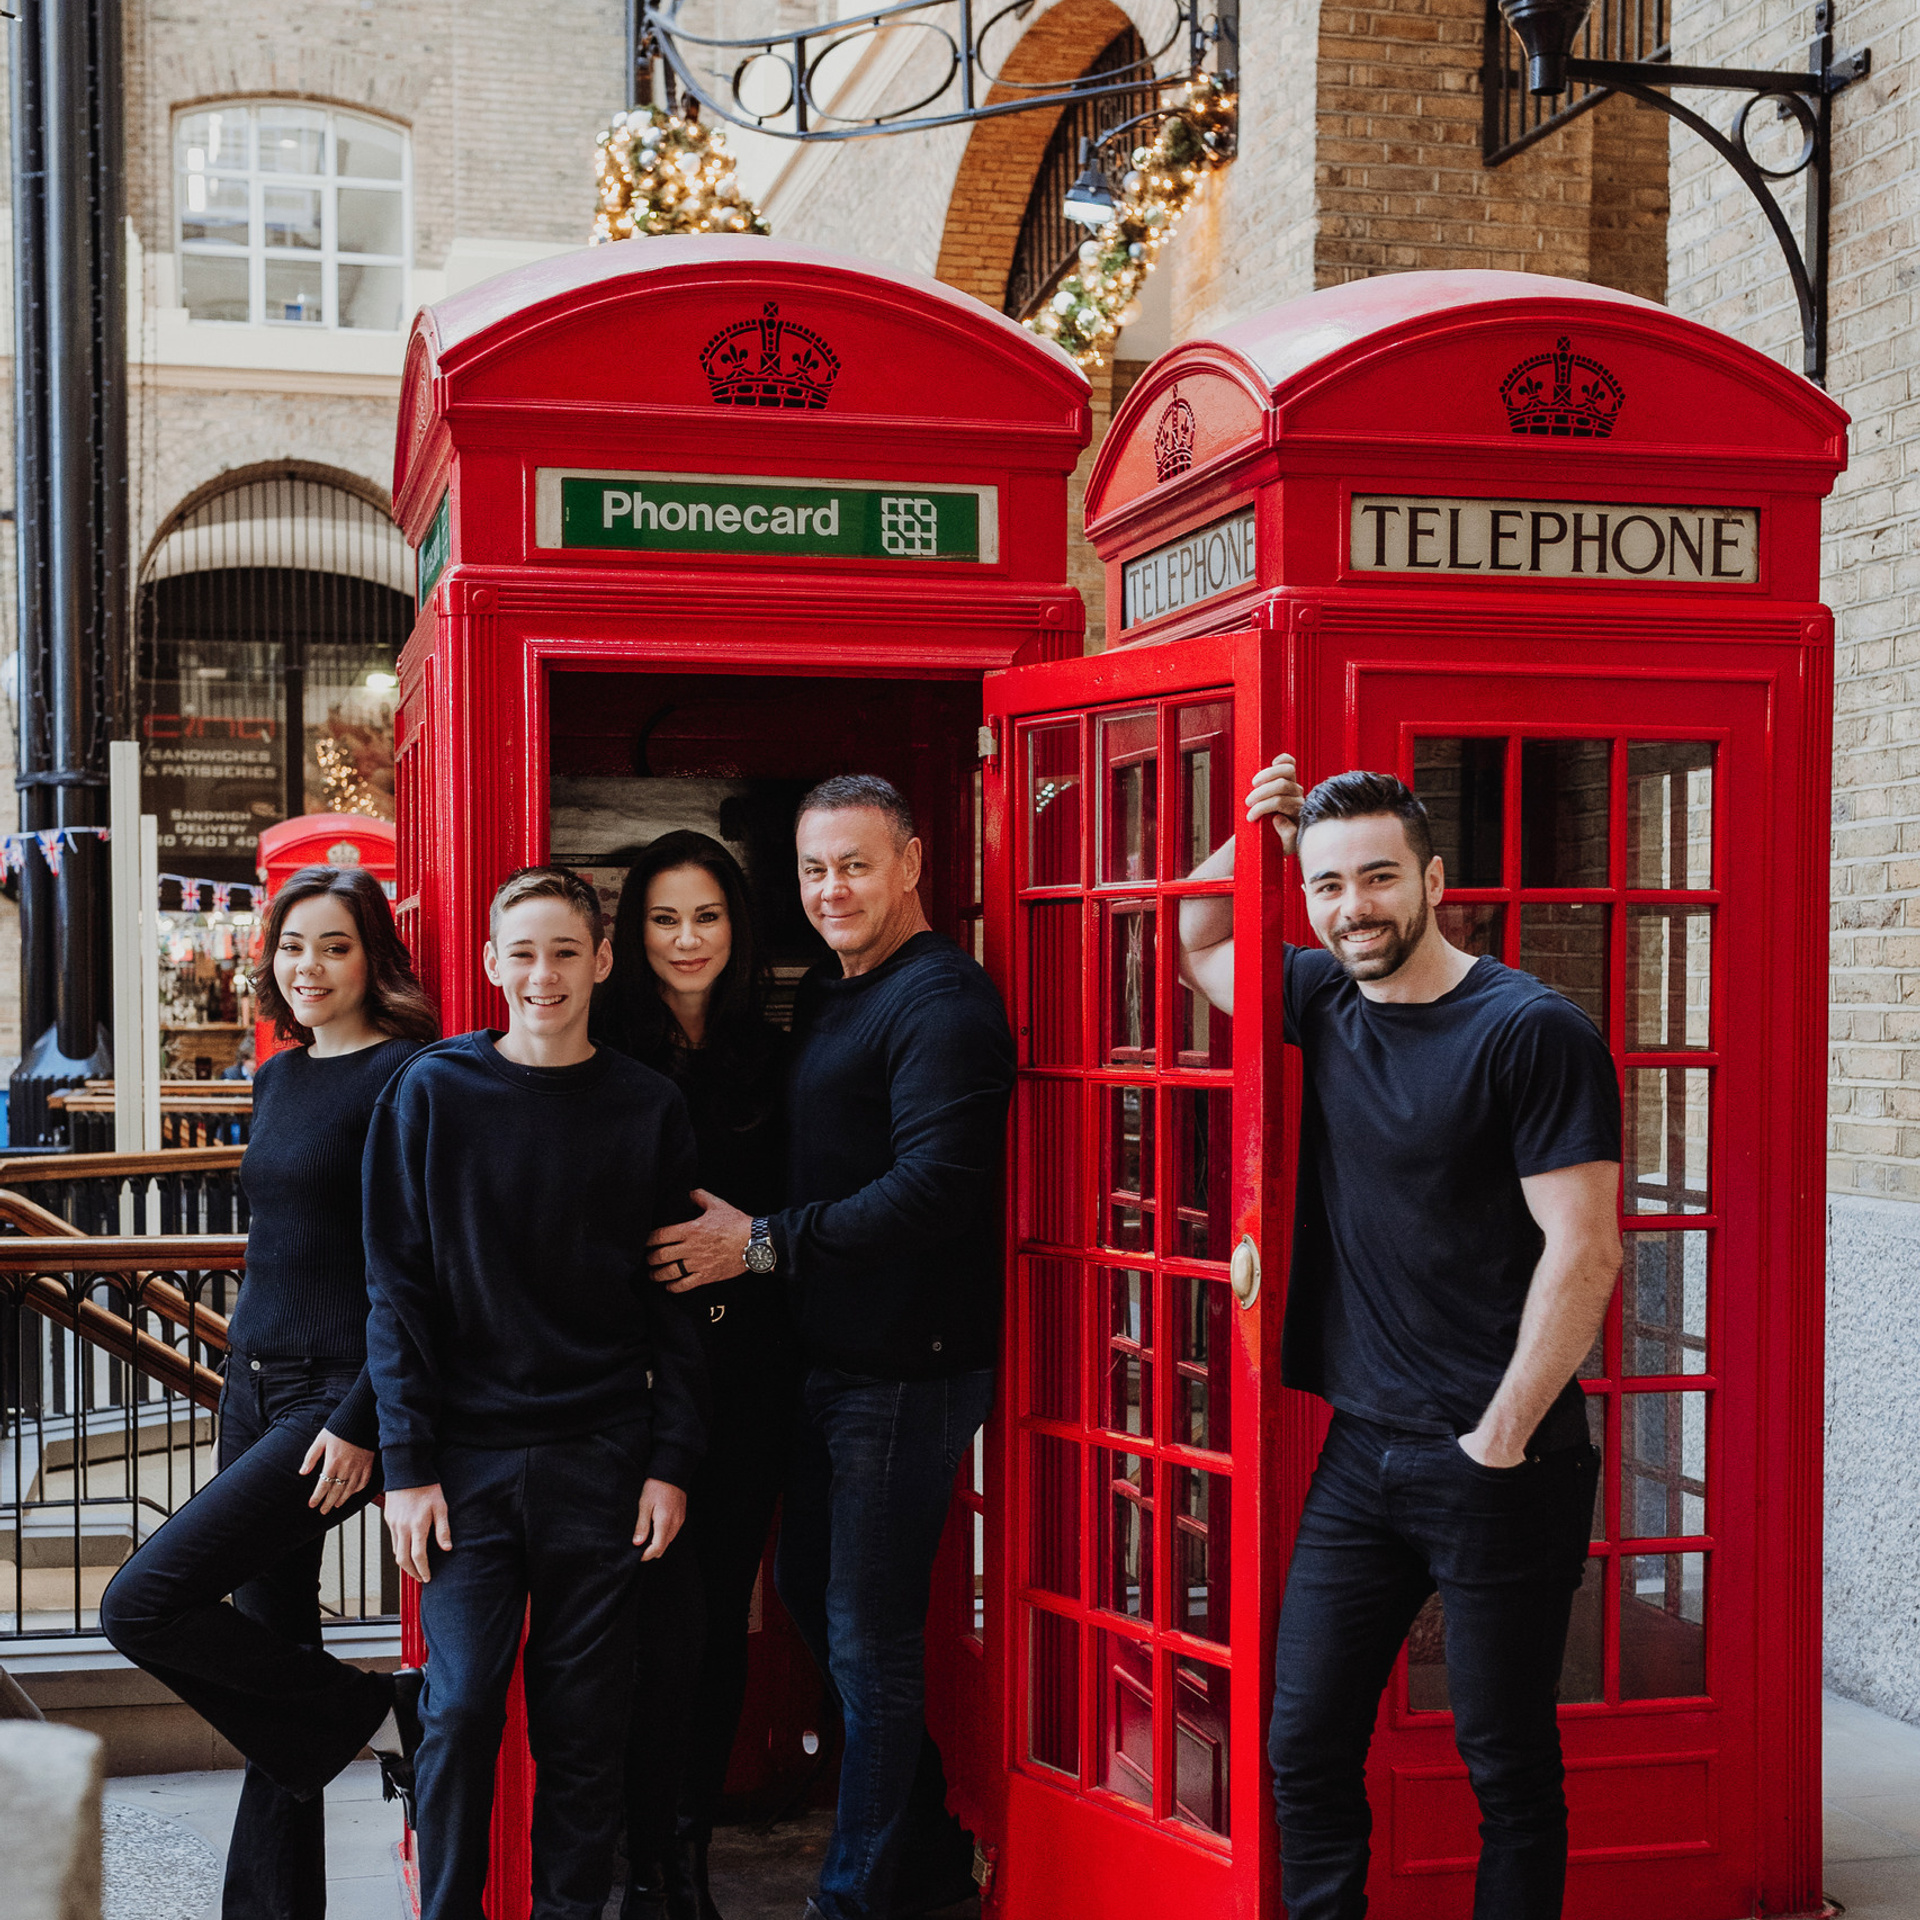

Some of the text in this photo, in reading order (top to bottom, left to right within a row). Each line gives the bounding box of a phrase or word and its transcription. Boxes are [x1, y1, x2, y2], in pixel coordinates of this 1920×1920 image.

[603, 490, 839, 536] Phonecard
[1361, 505, 1746, 577] TELEPHONE
[1129, 516, 1256, 620] TELEPHONE
[150, 748, 270, 762] SANDWICHES
[143, 764, 276, 779] & PATISSERIES
[170, 808, 252, 821] SANDWICH
[175, 822, 247, 834] DELIVERY
